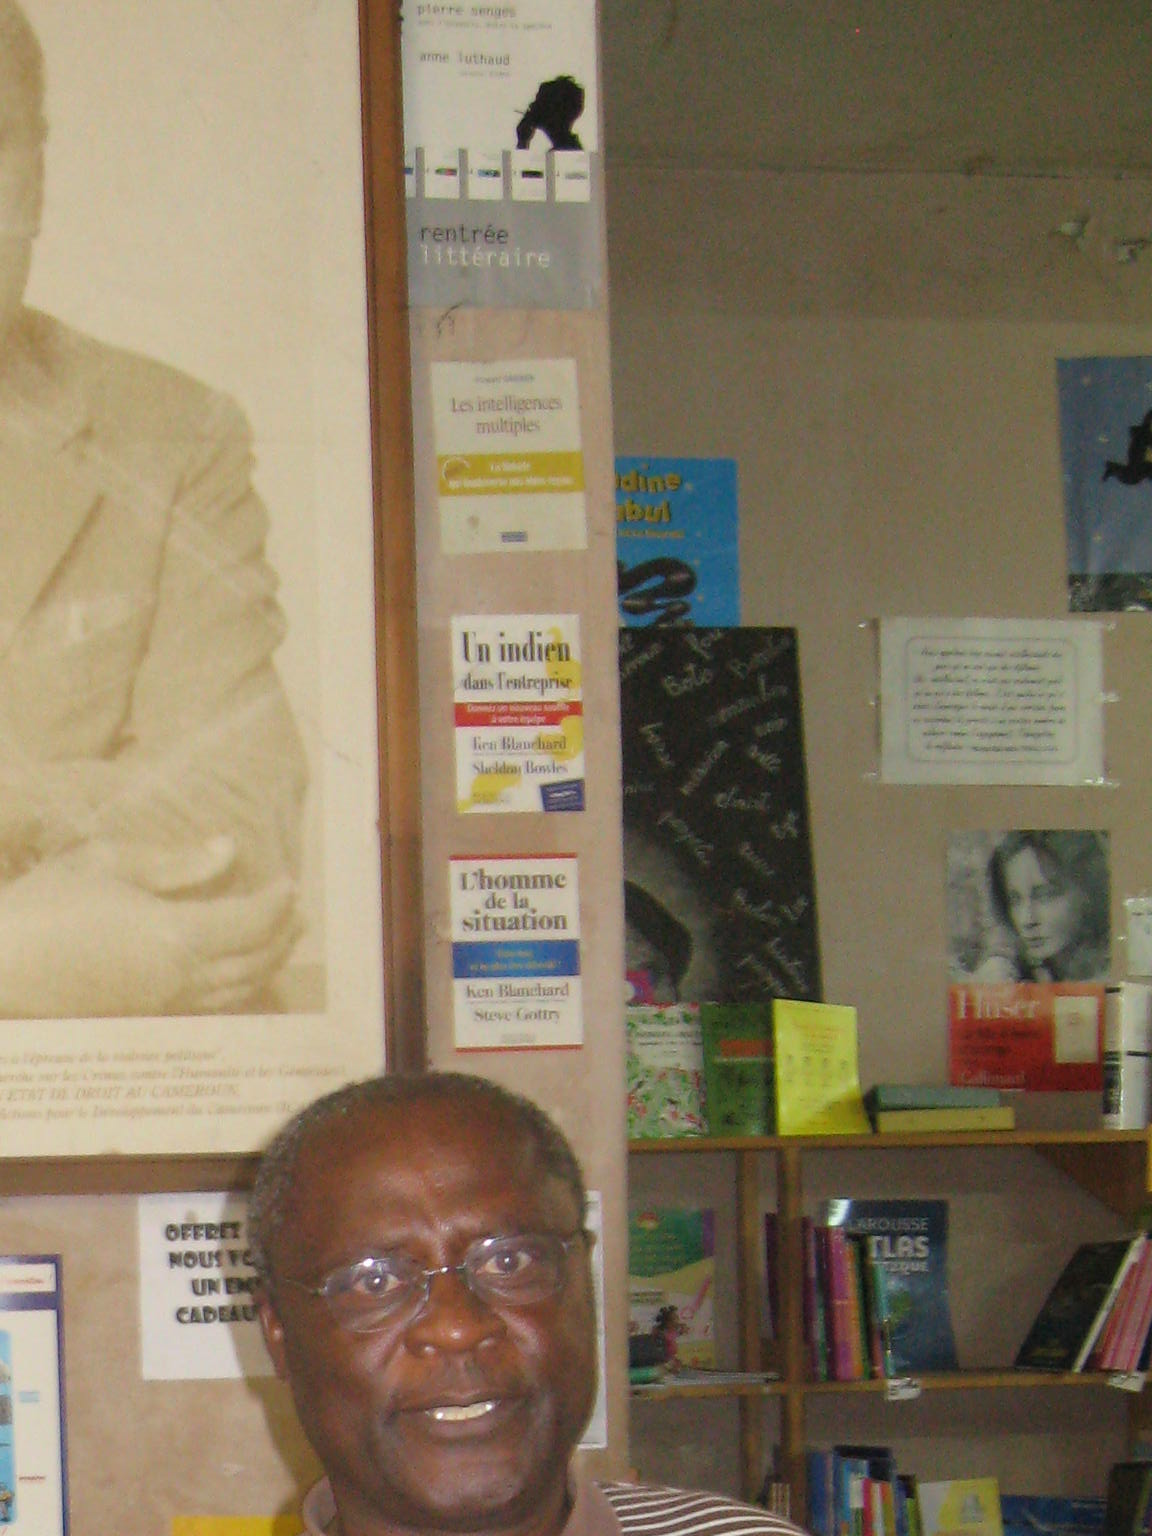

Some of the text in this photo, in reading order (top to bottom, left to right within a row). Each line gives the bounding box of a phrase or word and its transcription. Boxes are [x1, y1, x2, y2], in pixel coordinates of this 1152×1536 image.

[419, 50, 511, 66] anne luthaud
[420, 223, 509, 244] rentrée
[421, 244, 551, 268] littéraire
[451, 395, 564, 415] Les intelligences
[475, 416, 540, 438] multiples
[461, 631, 571, 664] Un indien
[462, 670, 573, 696] dans l'entreprise
[472, 735, 567, 751] Ken Blanchard
[525, 760, 569, 775] Bowles
[459, 868, 567, 891] L'homme
[484, 893, 530, 909] de la
[461, 908, 568, 932] situation
[465, 983, 570, 999] Ken Blanchard
[473, 1008, 512, 1022] Steve
[871, 1234, 930, 1259] TLAS
[175, 1304, 259, 1325] CADEAU
